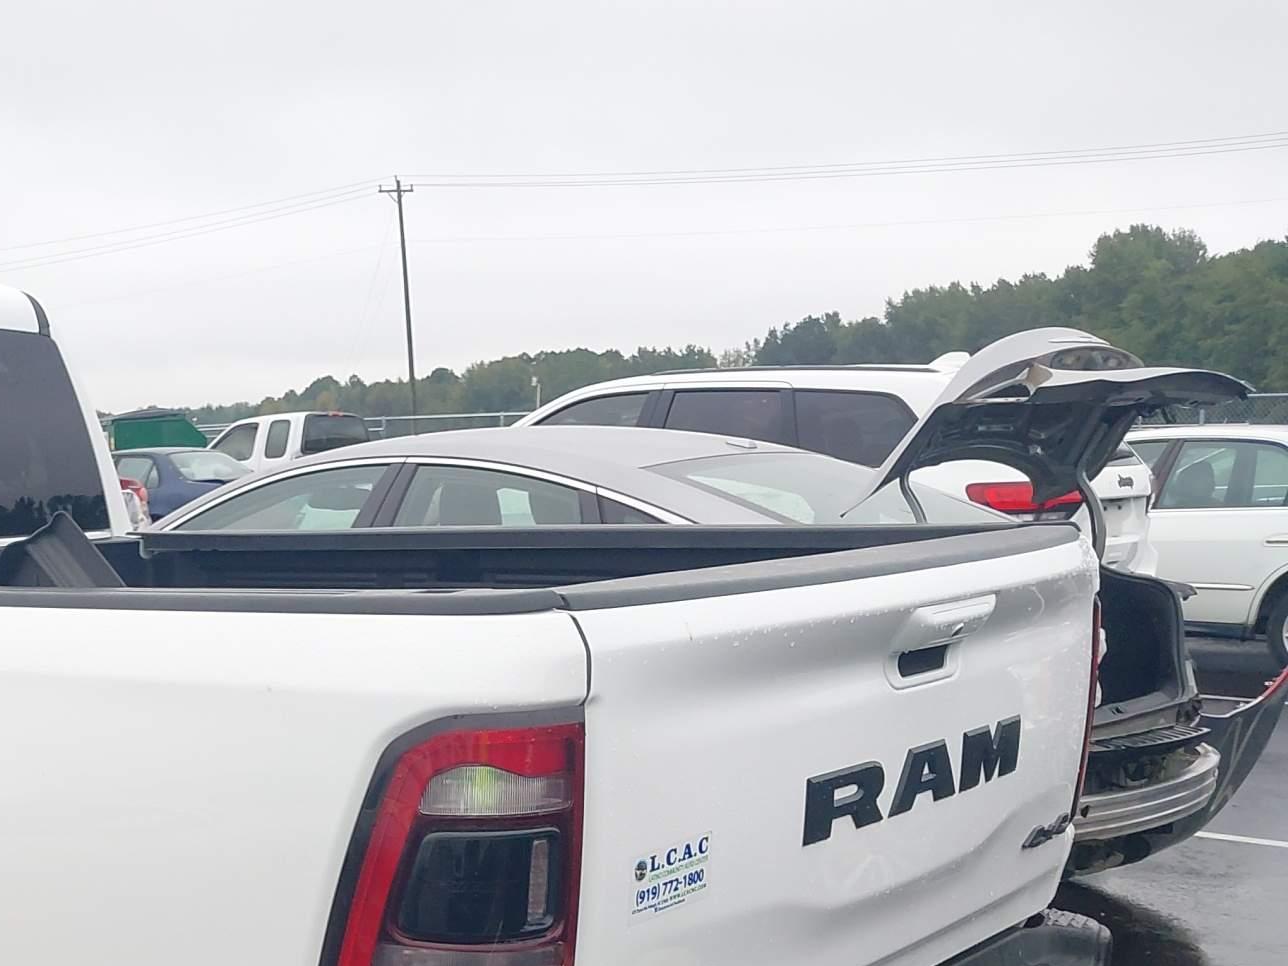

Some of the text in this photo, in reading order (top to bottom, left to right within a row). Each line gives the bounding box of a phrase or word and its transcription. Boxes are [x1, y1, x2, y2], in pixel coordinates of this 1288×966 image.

[802, 714, 1021, 847] RAM
[649, 836, 709, 873] L.C.A.C
[635, 882, 661, 907] (919)
[662, 867, 705, 897] 772-1800
